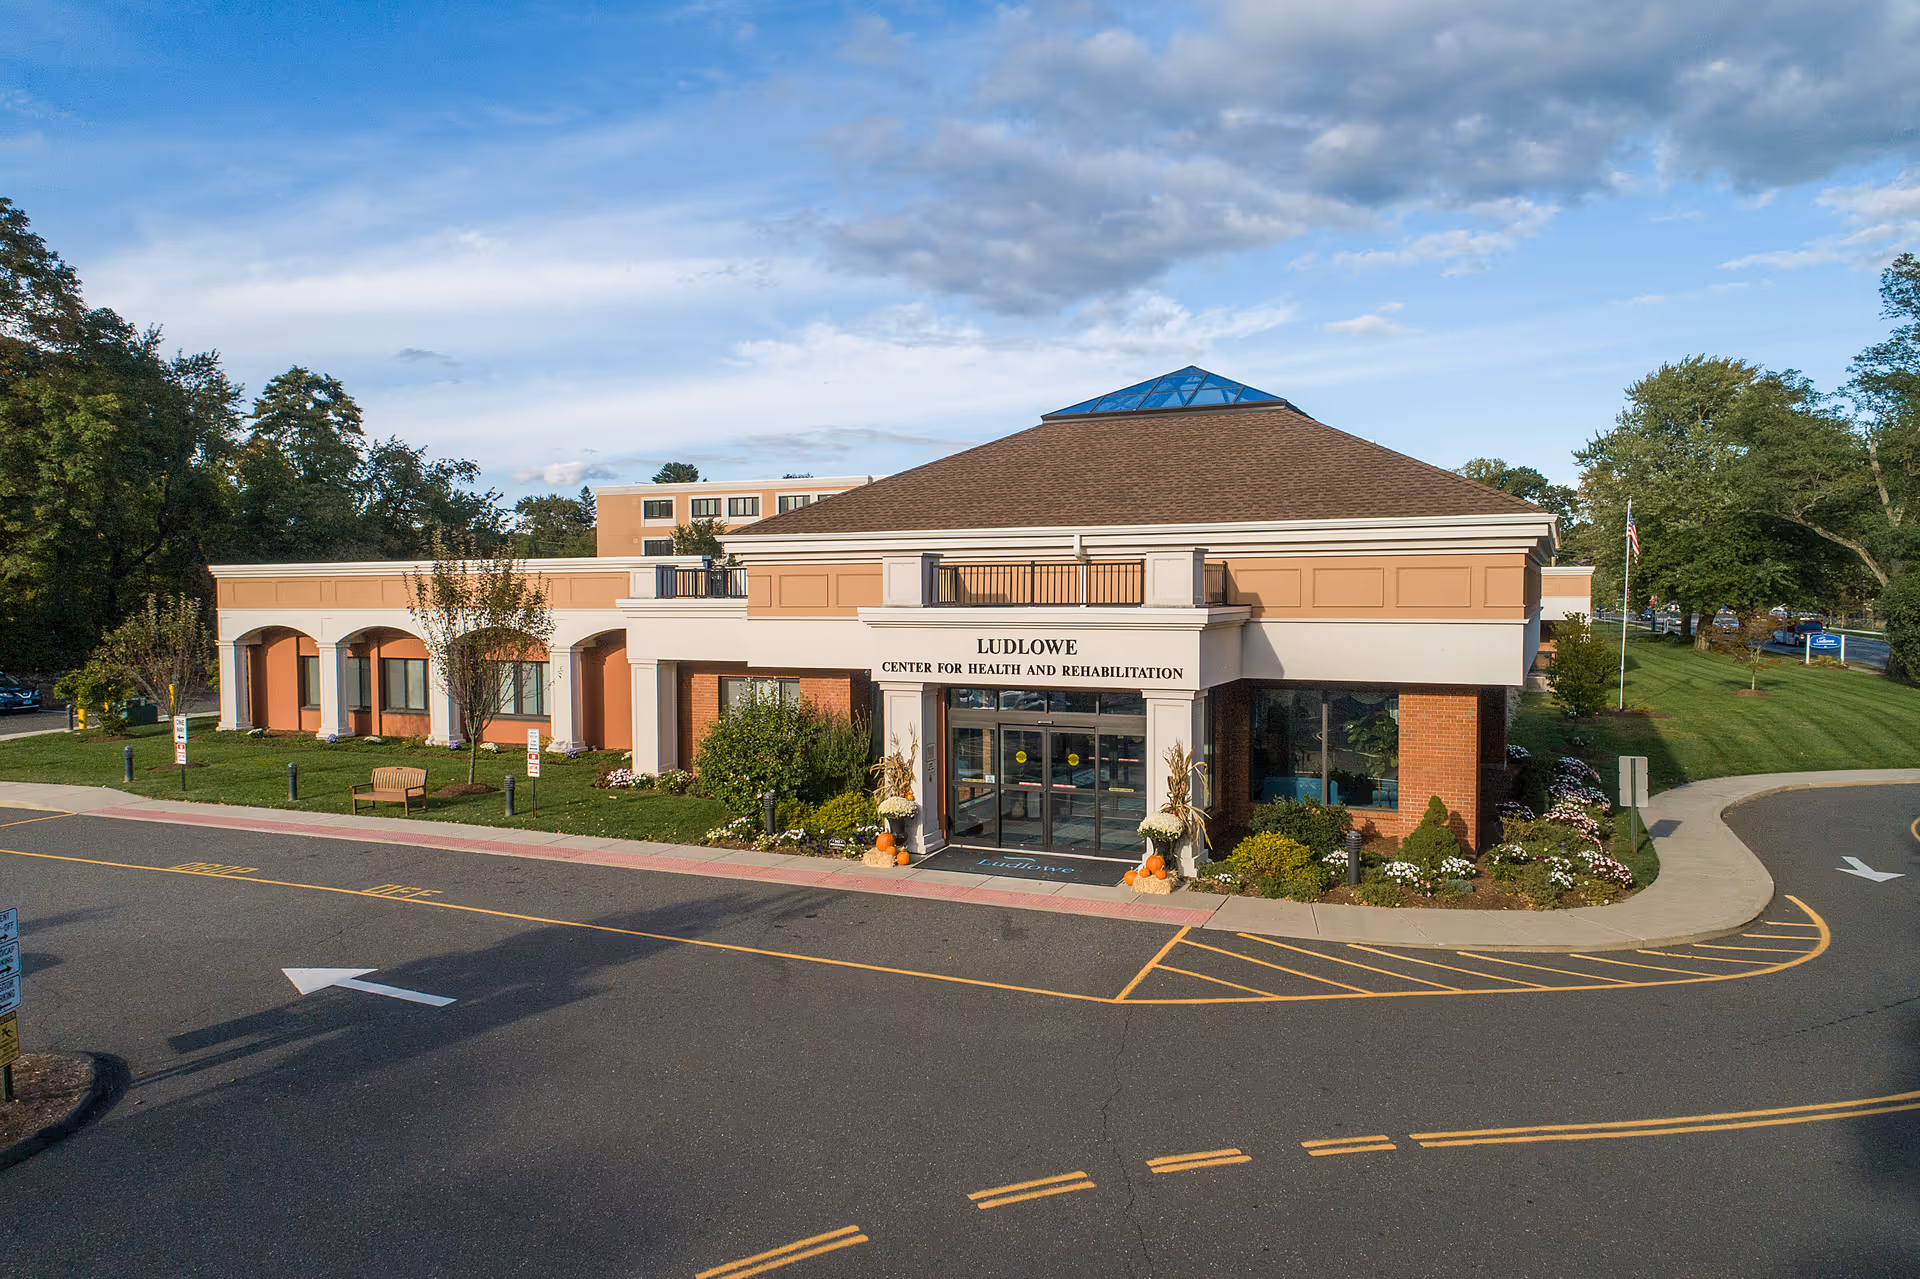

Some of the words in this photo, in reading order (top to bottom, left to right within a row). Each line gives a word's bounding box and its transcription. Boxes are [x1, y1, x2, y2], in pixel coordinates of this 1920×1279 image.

[977, 638, 1078, 655] LUDLOWE
[882, 661, 932, 674] CENTER
[937, 662, 963, 674] FOR
[968, 663, 1021, 676] HEALTH
[1027, 664, 1057, 677] AND
[1062, 664, 1184, 680] REHABILITATION
[977, 859, 1075, 873] Ludlowe
[169, 862, 260, 875] DROP
[361, 884, 444, 898] OFF
